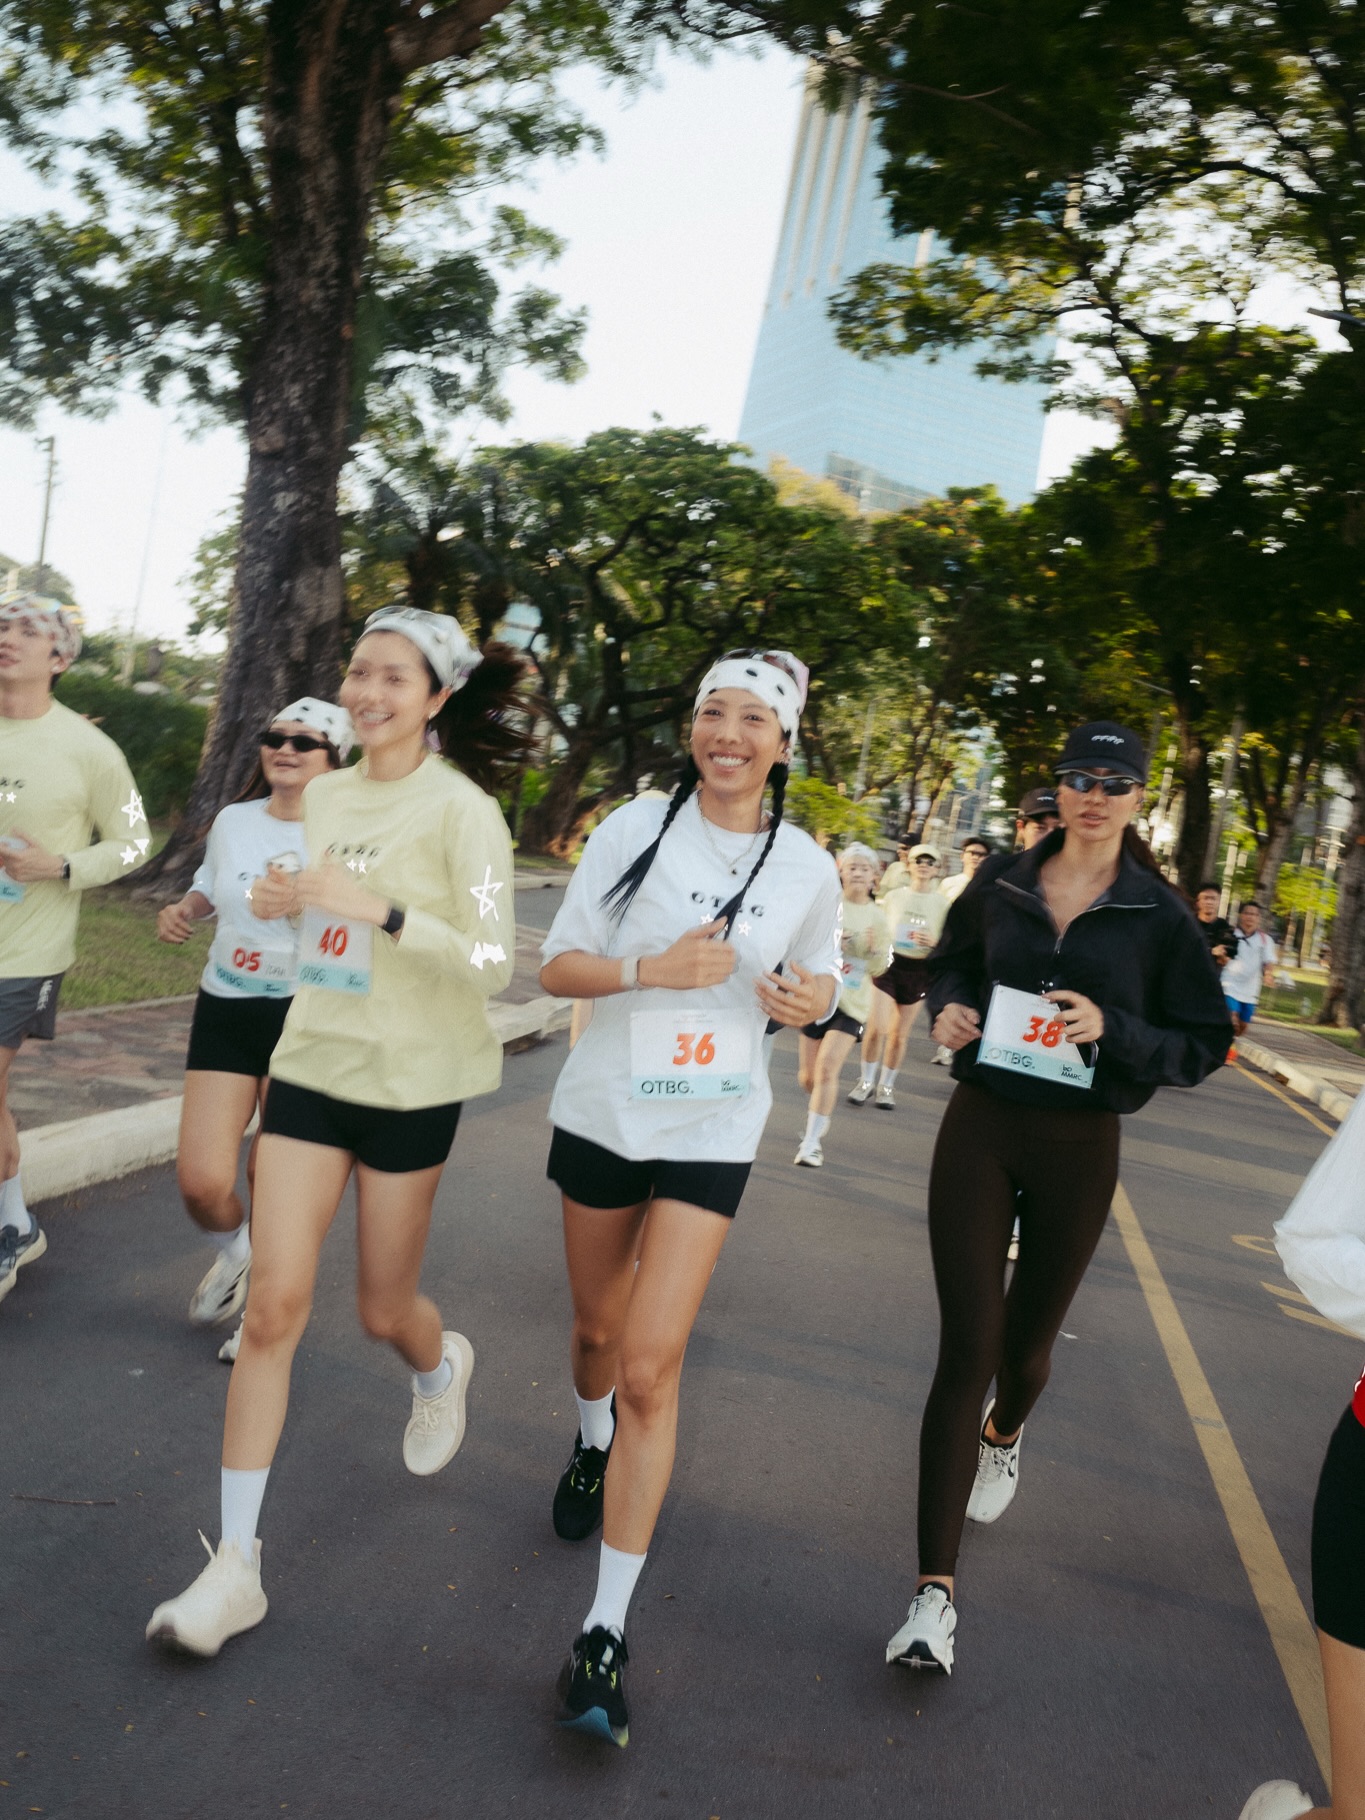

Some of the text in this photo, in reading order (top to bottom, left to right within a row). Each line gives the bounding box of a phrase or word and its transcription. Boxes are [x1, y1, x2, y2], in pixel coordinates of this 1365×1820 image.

[690, 891, 765, 917] OTG
[318, 925, 349, 957] 40
[233, 948, 262, 972] 05
[1022, 1015, 1066, 1048] 38
[672, 1032, 715, 1065] 36
[641, 1080, 694, 1094] OTBG.
